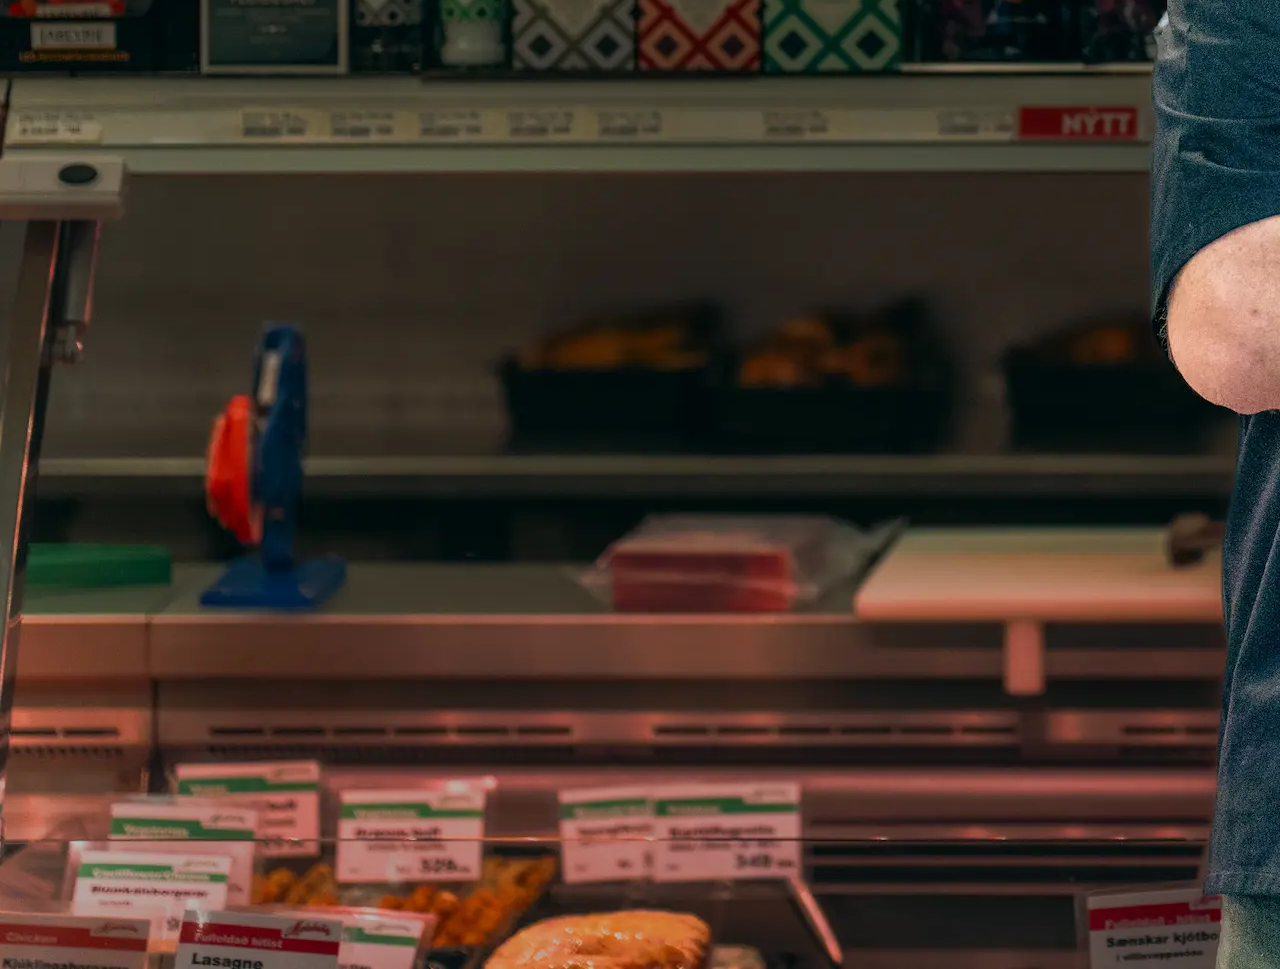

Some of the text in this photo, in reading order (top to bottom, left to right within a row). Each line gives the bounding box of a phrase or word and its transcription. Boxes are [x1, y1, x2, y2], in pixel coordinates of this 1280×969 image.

[1060, 110, 1132, 135] NÝTT
[1106, 934, 1170, 948] Sænskar
[192, 952, 264, 969] Lasagne
